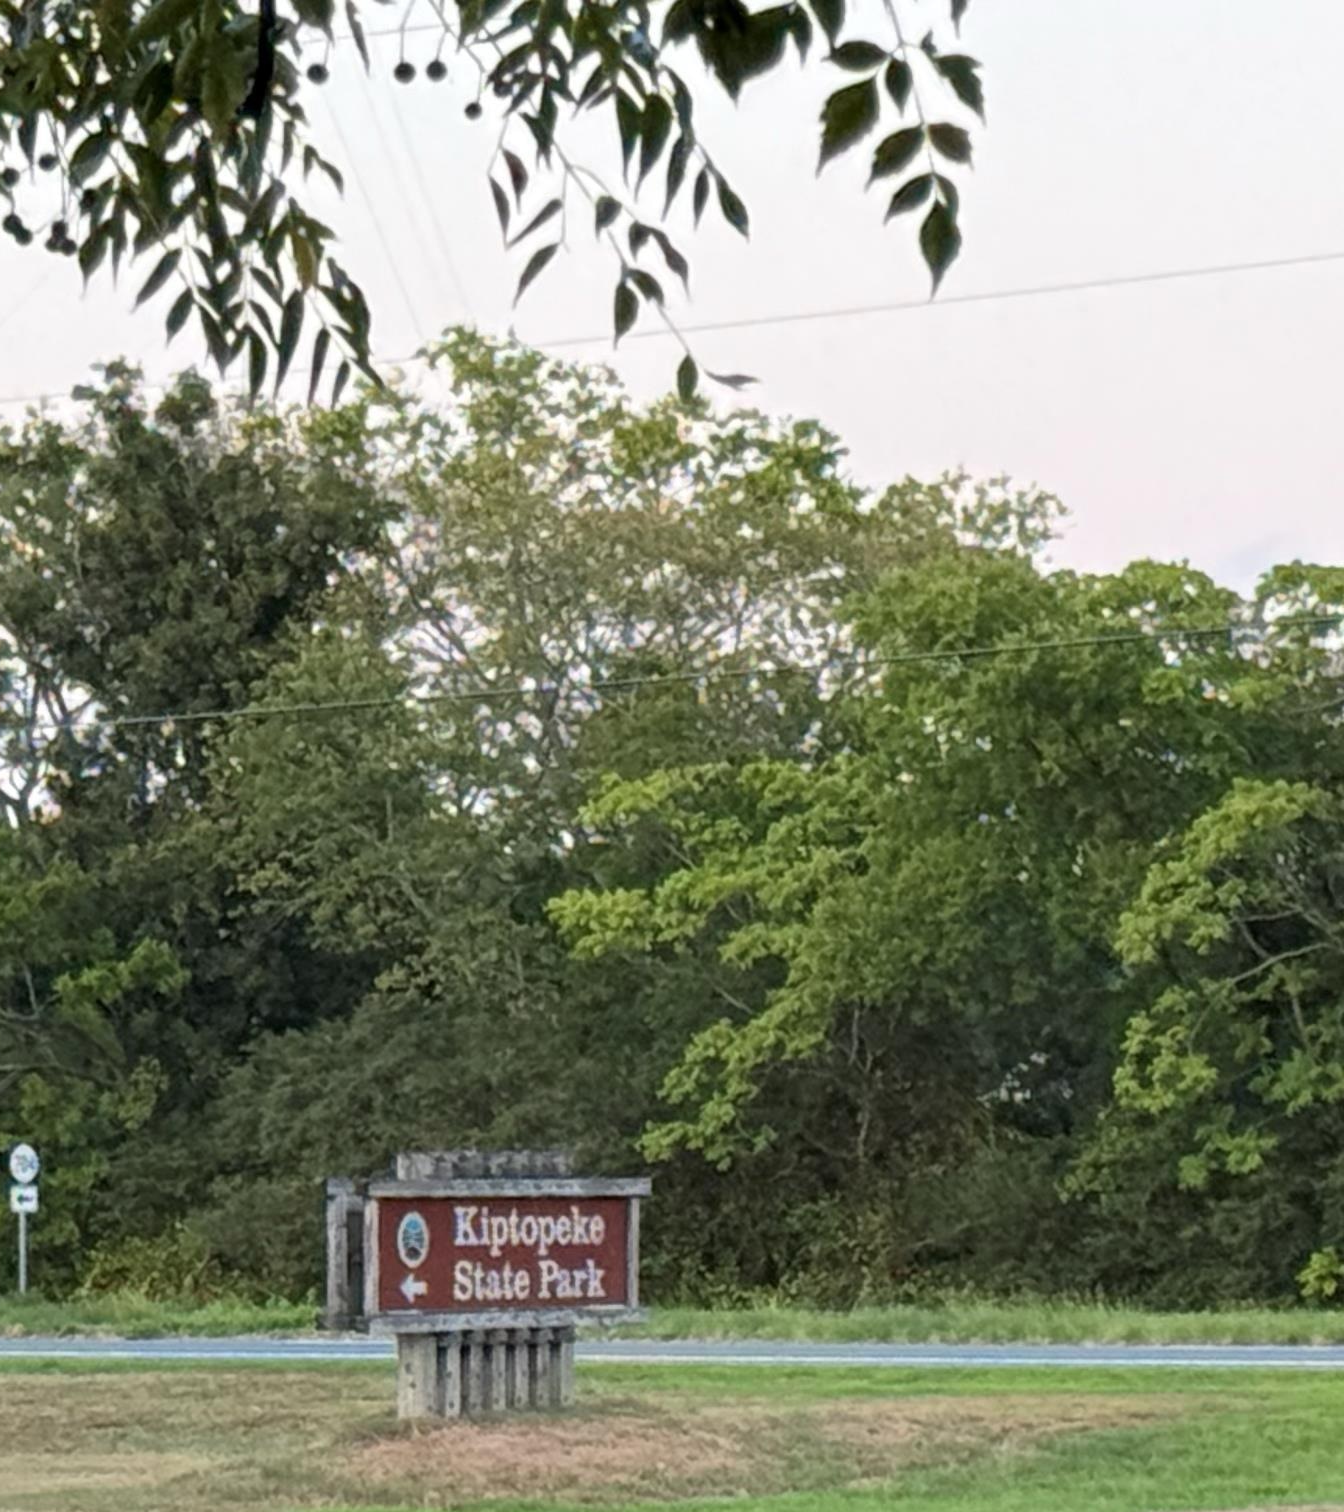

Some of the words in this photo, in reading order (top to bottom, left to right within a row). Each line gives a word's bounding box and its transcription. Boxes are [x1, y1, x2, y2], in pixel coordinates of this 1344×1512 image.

[454, 1205, 605, 1257] Kiptopeke
[454, 1260, 530, 1300] State
[538, 1258, 606, 1299] Park
